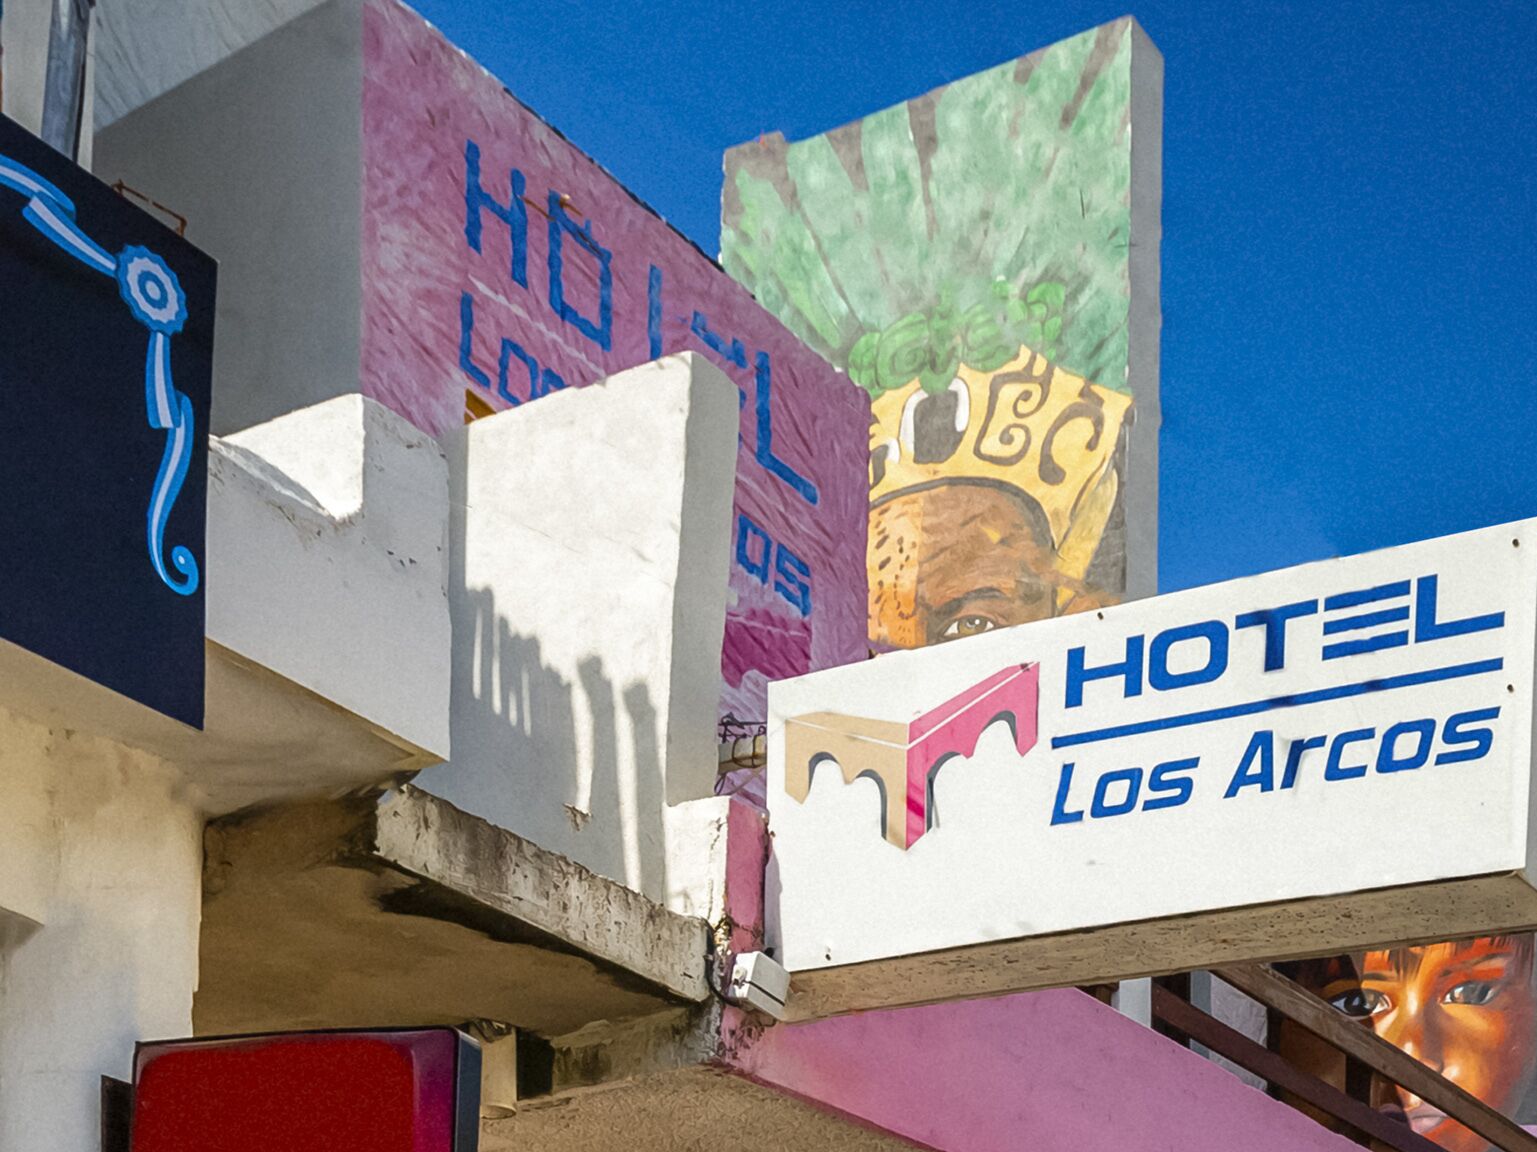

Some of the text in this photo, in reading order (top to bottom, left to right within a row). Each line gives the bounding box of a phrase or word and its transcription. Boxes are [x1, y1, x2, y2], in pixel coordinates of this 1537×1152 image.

[1064, 574, 1506, 709] HOTEL
[1050, 706, 1501, 826] Los Arcos
